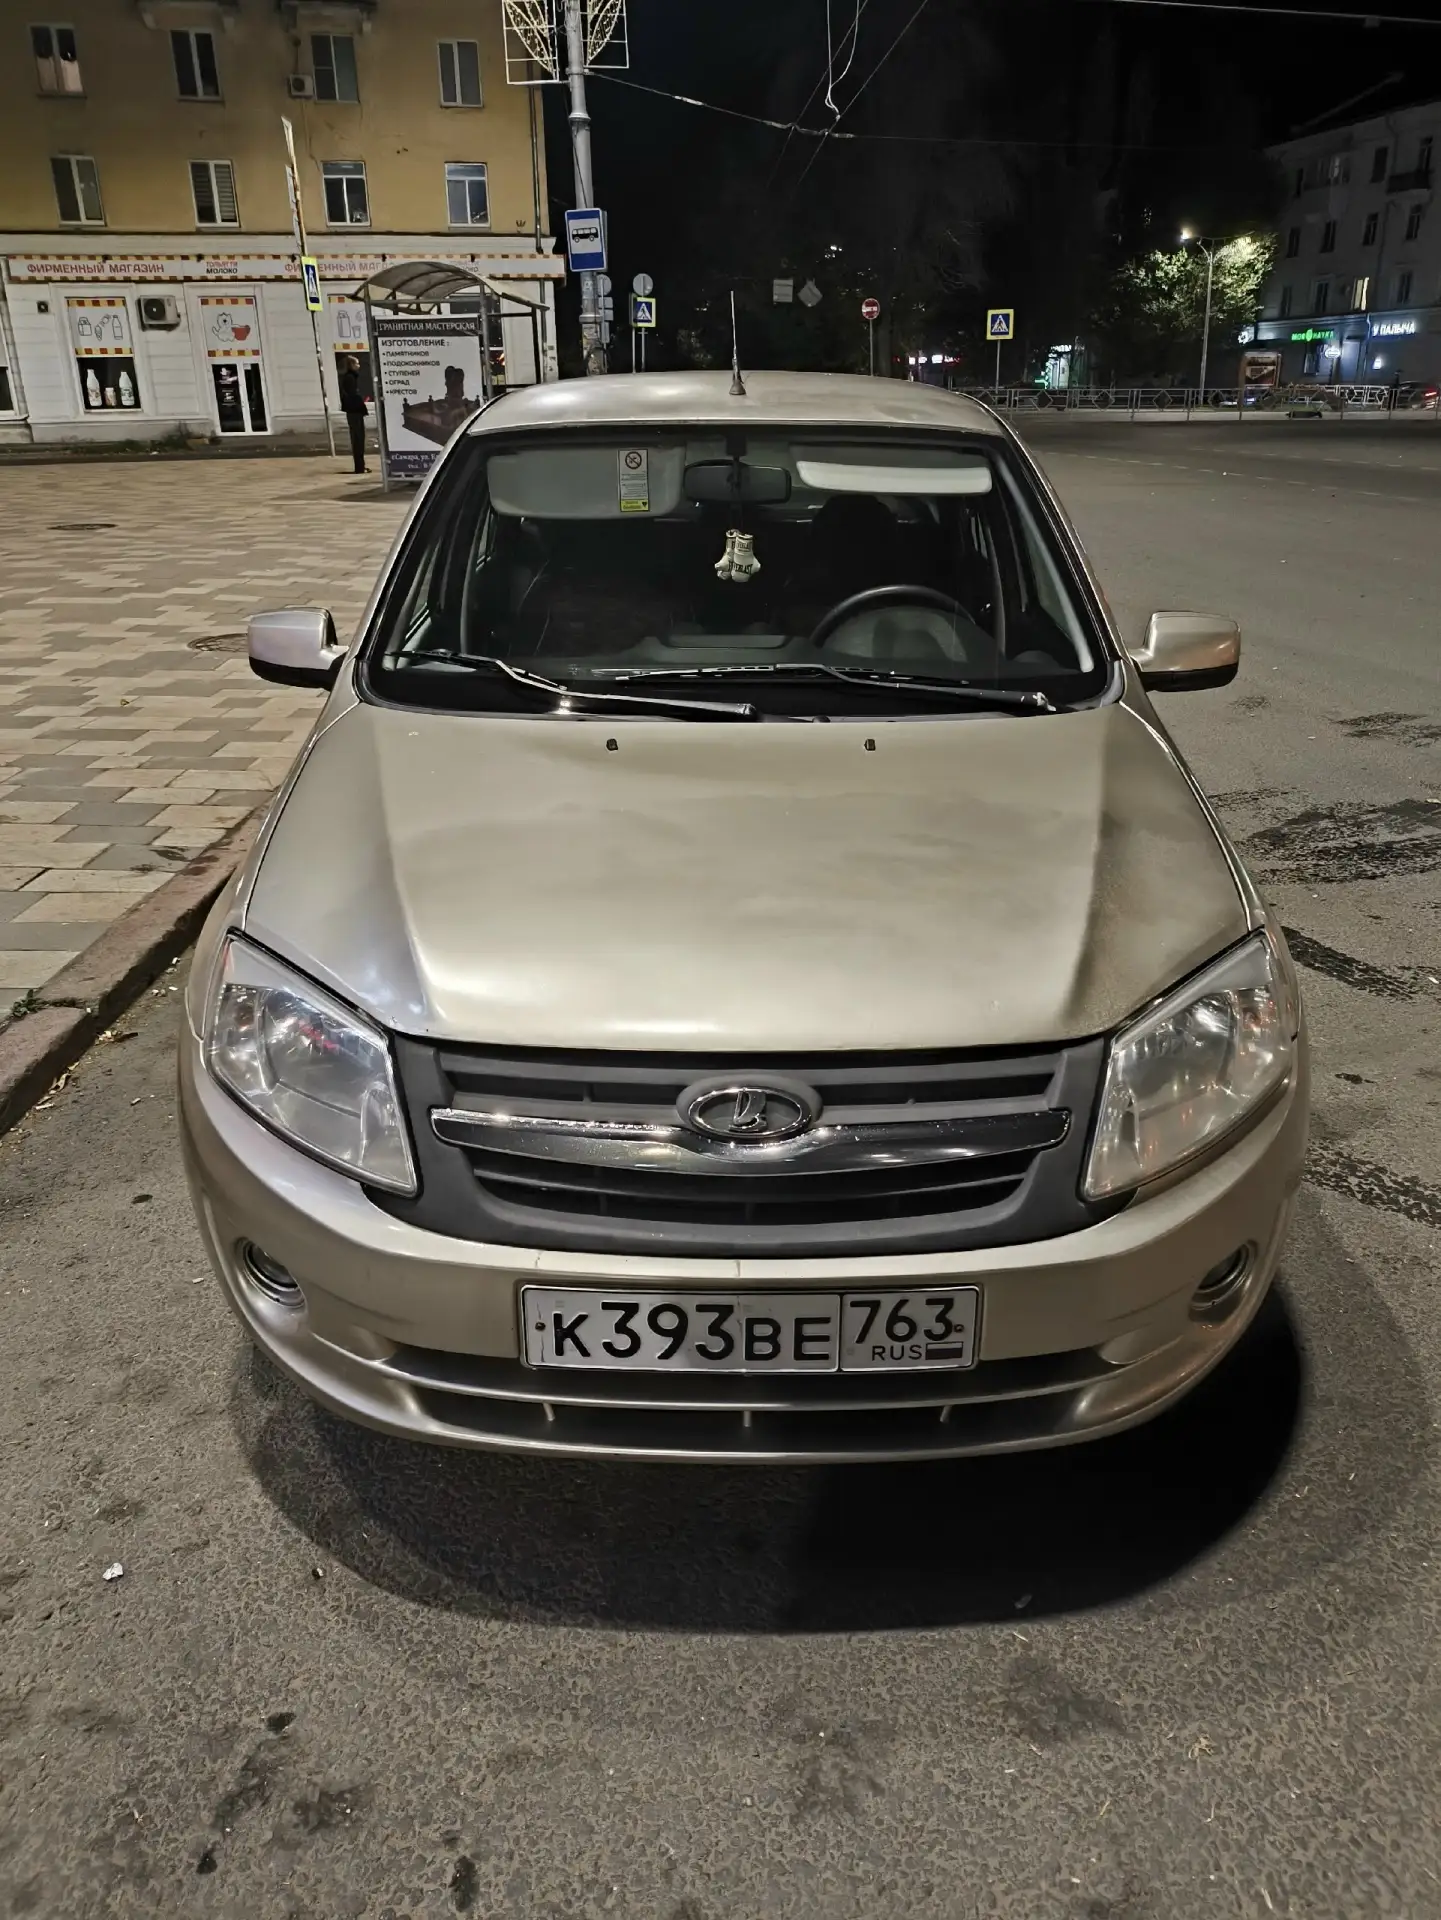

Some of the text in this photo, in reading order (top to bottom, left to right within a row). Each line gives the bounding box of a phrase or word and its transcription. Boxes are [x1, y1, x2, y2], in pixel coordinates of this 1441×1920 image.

[27, 263, 165, 274] ФИРМЕННЫЙ МАГАЗИН
[284, 262, 356, 273] ФИЕННЫЙ
[379, 322, 475, 331] ГРАНИТНАЯ МАСТЕРСКАЯ
[849, 1297, 957, 1344] 763
[871, 1344, 922, 1361] RUS
